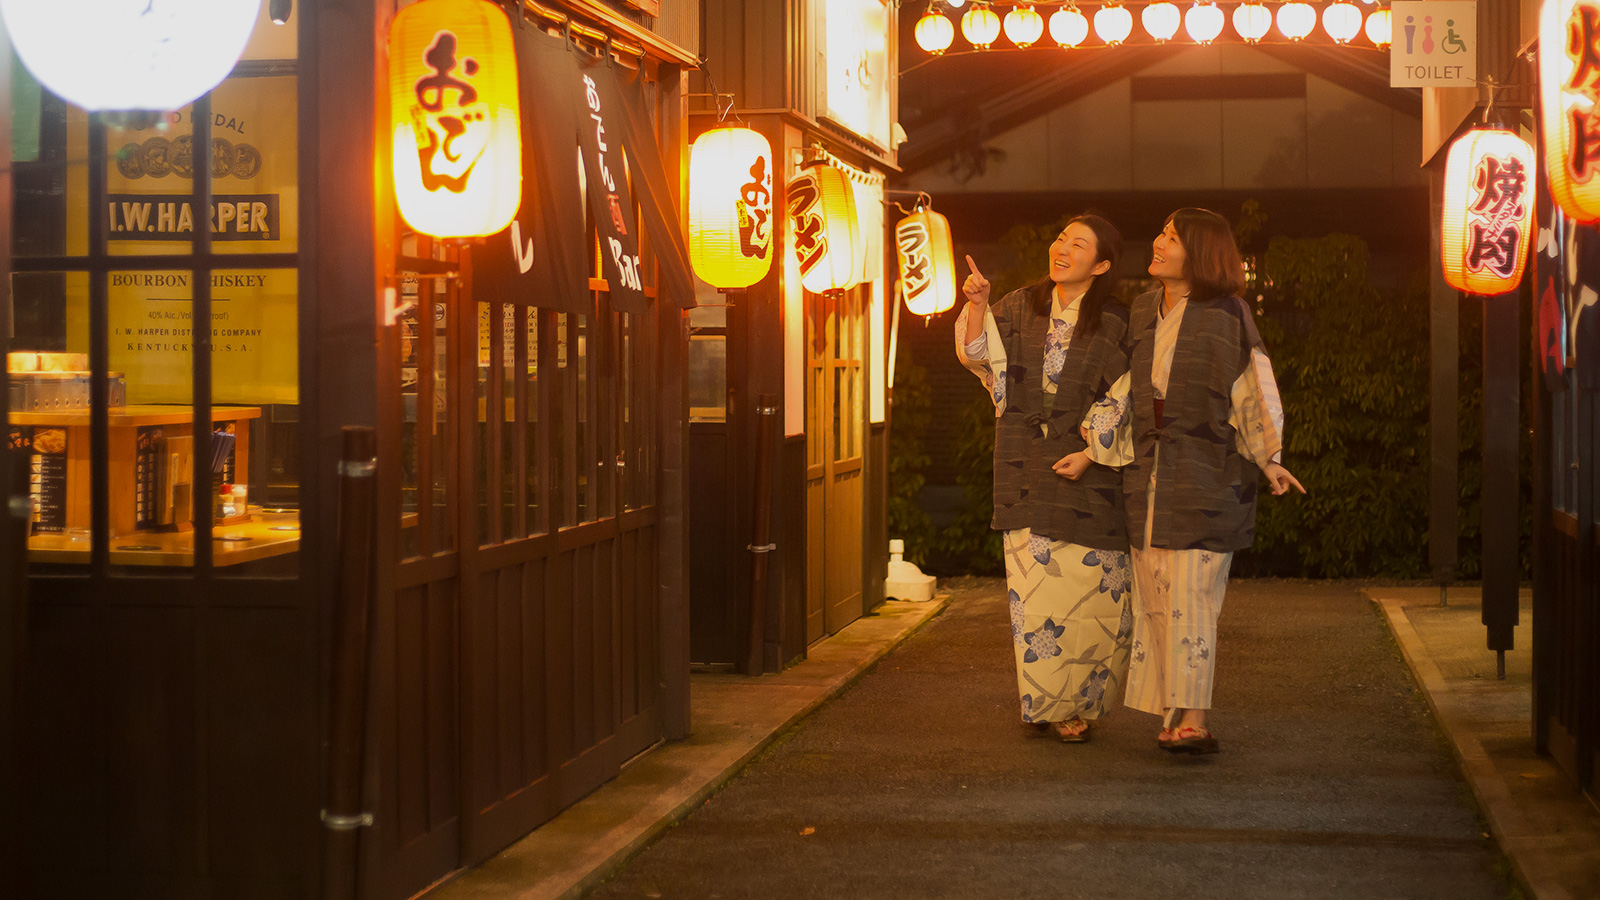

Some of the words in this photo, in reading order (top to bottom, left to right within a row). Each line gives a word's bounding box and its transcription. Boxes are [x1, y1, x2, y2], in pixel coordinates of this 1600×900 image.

[1404, 65, 1463, 79] TOILET
[415, 33, 484, 193] おでん
[739, 155, 771, 260] おでん
[787, 176, 827, 277] ラーメン
[1467, 154, 1527, 277] 焼肉
[1484, 201, 1515, 241] スタミナ
[112, 274, 187, 287] BOURBON
[210, 274, 267, 287] HISKEY
[608, 236, 642, 291] Bar
[898, 223, 933, 302] ラーメン
[138, 328, 170, 336] HARPER
[221, 329, 262, 337] COMPANY
[148, 311, 162, 320] 40%
[210, 312, 229, 321] roof)
[210, 344, 253, 352] U.S.A.
